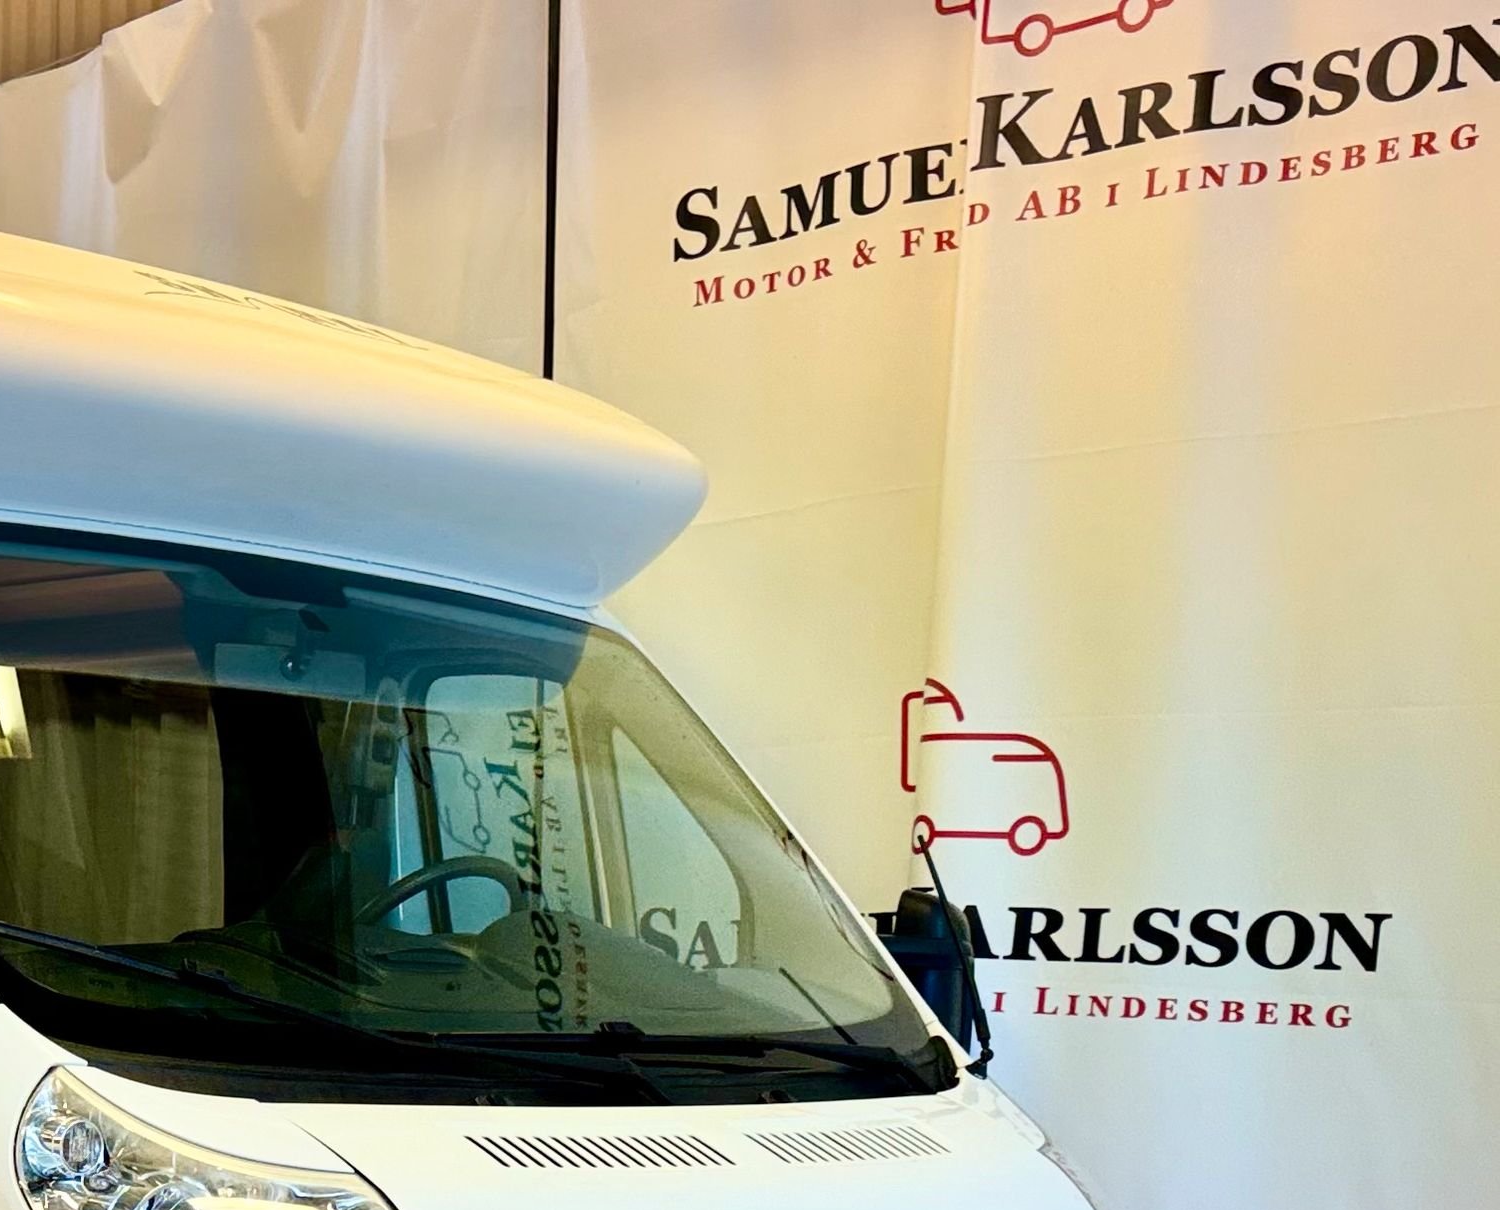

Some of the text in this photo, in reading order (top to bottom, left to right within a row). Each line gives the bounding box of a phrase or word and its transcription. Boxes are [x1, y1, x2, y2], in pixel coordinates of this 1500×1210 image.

[673, 18, 1500, 262] SAMUE KARLSSON
[693, 257, 833, 307] MOTOR
[852, 239, 876, 268] &
[1016, 186, 1082, 222] AB
[1104, 183, 1121, 207] I
[1143, 123, 1480, 200] LINDESBERG
[963, 905, 1393, 972] ARLSSON
[990, 987, 1352, 1028] I LINDESBERG
